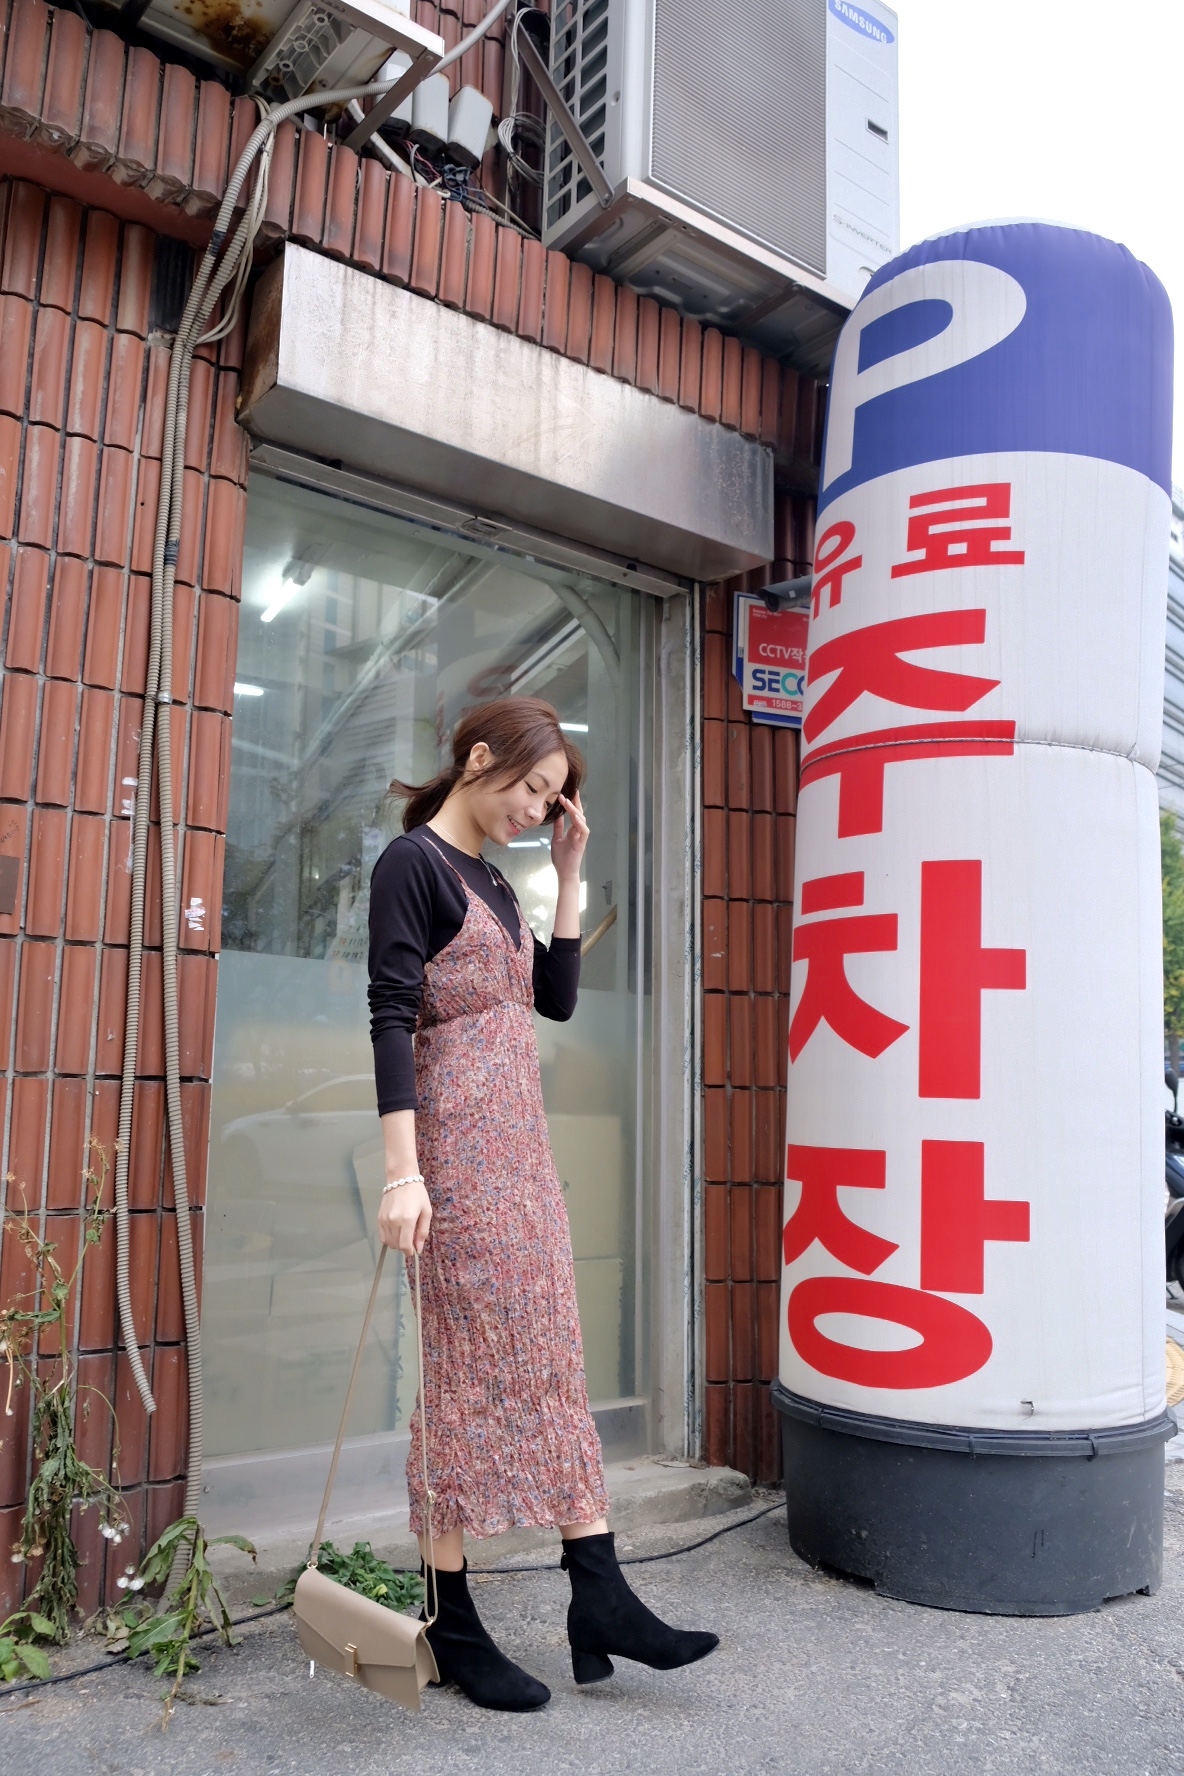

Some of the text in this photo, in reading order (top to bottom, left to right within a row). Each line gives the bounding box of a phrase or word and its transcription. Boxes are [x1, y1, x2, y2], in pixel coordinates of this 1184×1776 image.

[834, 0, 887, 44] SAMSUNG
[832, 214, 892, 254] S-INVERTER
[823, 259, 1027, 494] P
[811, 482, 1026, 620] 유료
[759, 643, 807, 664] CCTV작
[783, 608, 1031, 1389] 주차장
